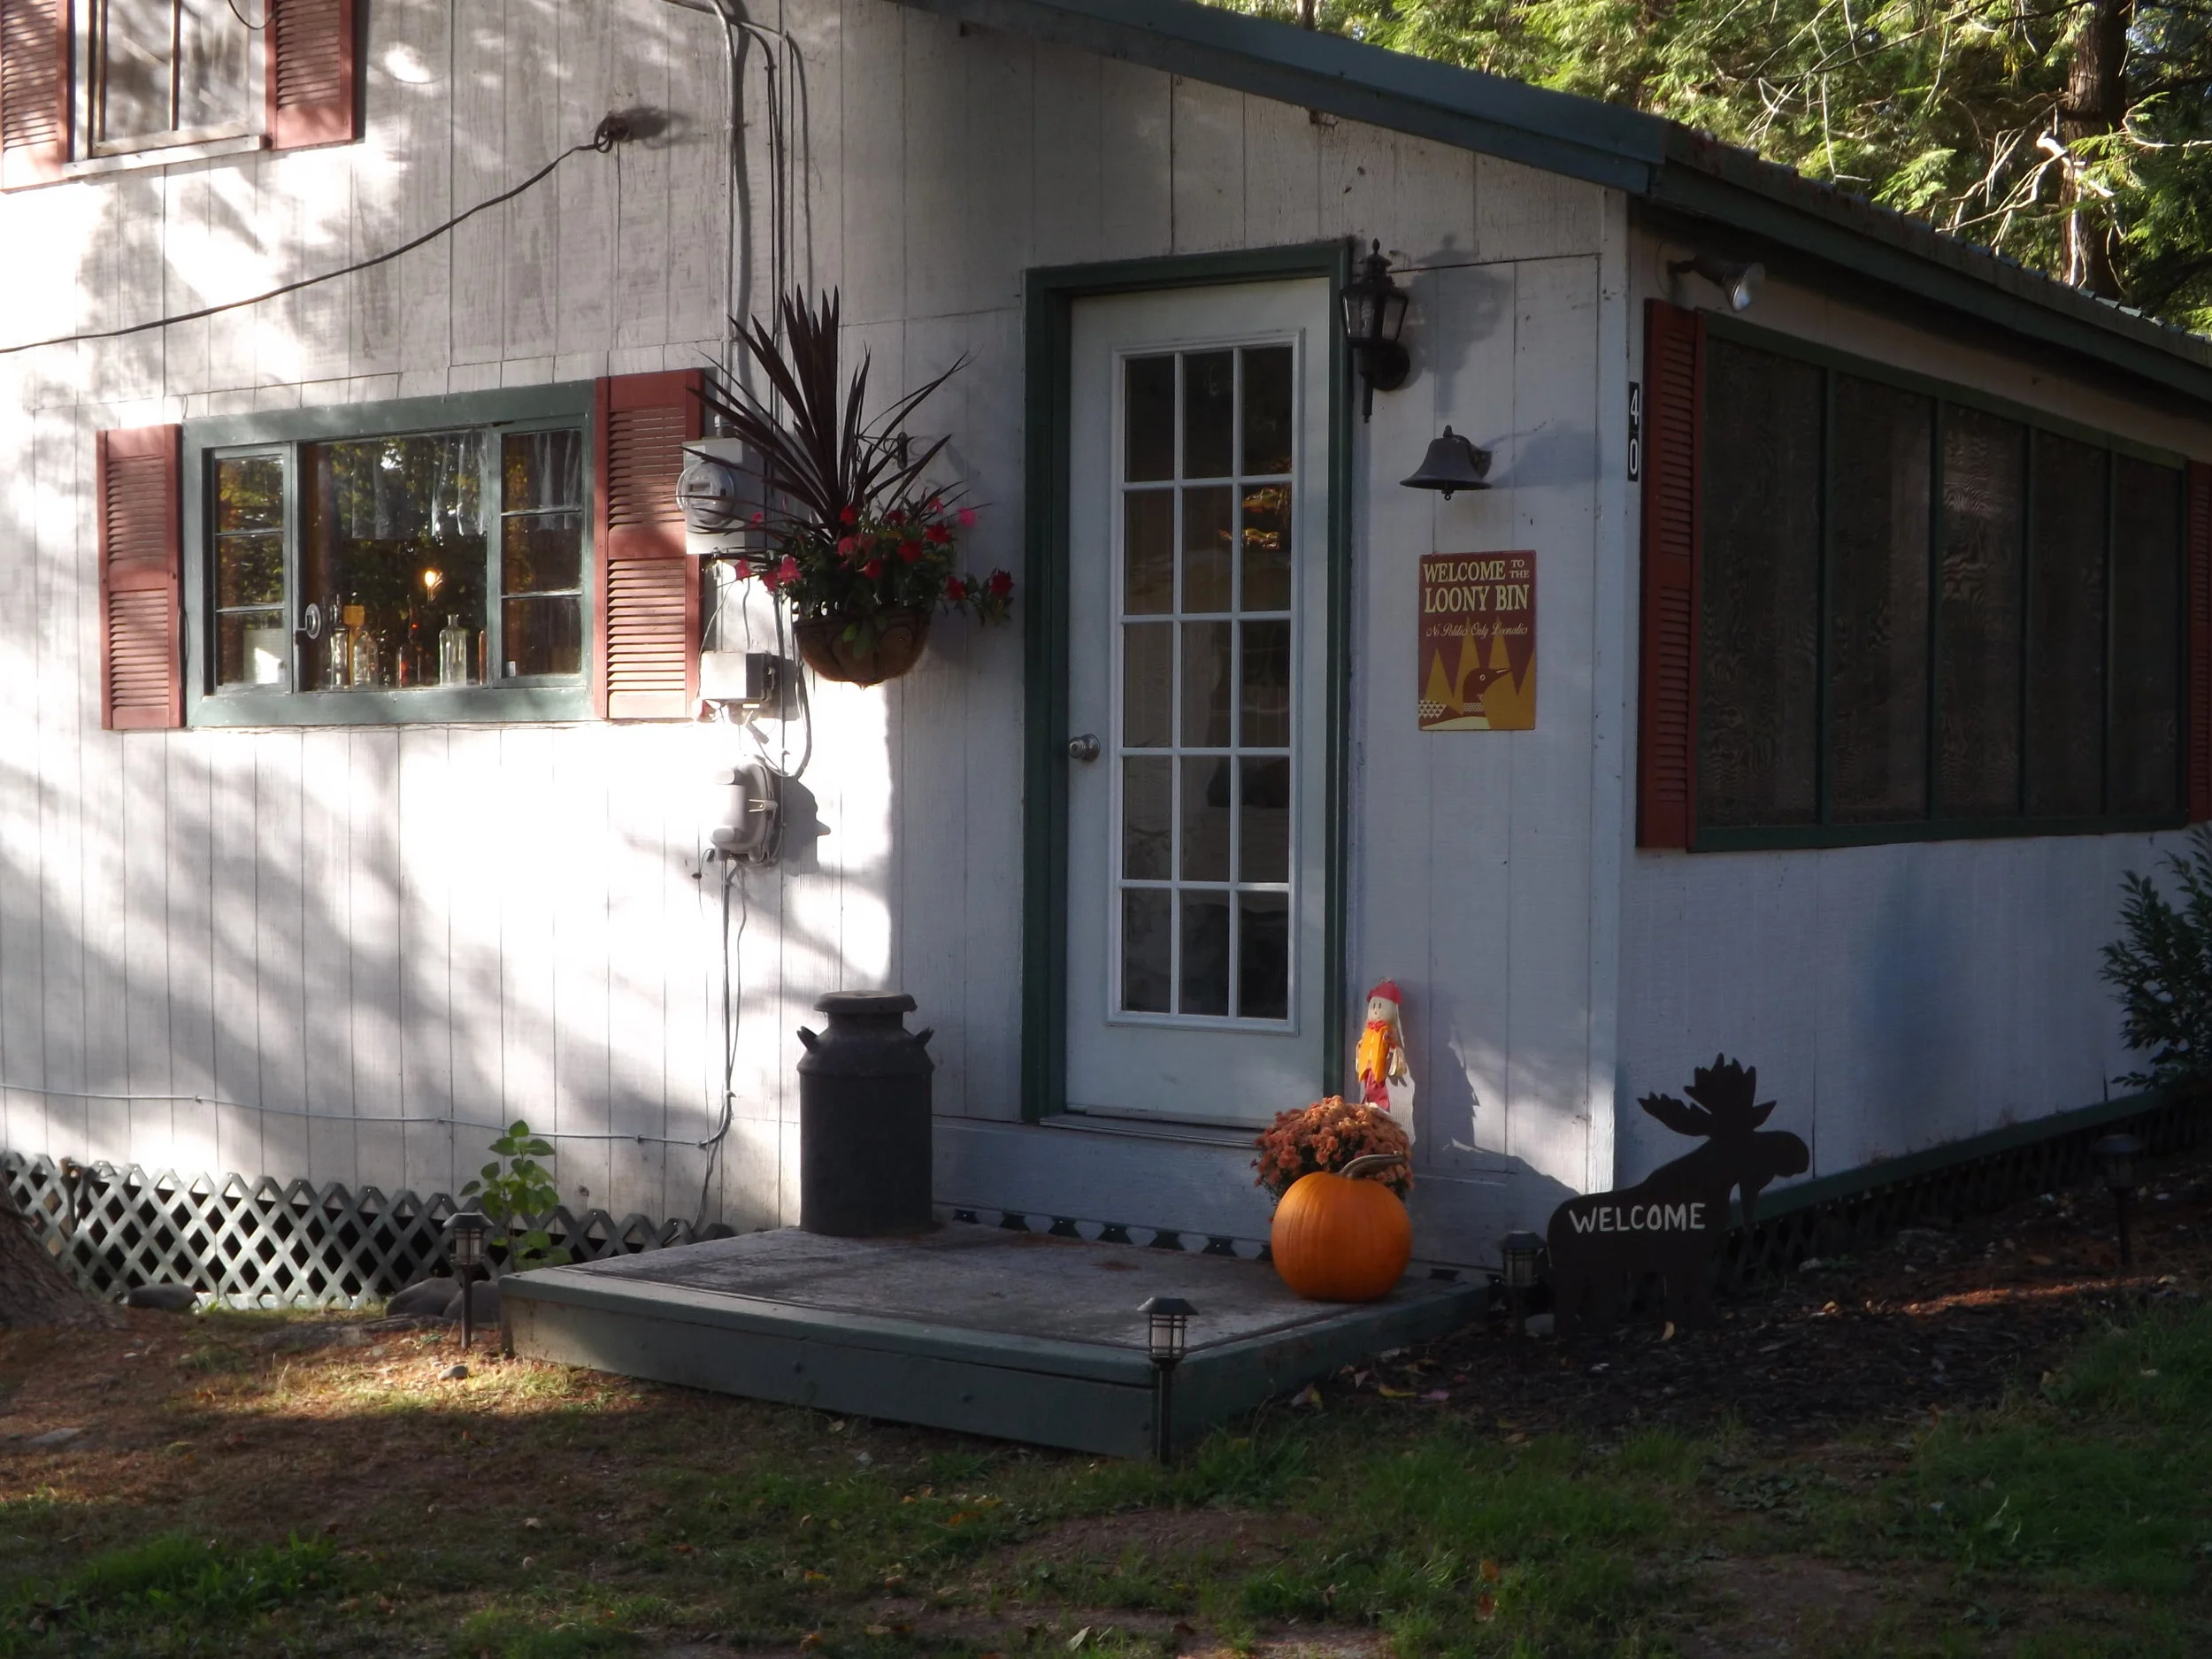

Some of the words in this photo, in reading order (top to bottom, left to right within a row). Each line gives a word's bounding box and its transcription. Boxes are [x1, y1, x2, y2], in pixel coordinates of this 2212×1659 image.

[1630, 388, 1639, 475] 40
[1423, 560, 1506, 584] WELCOME
[1510, 559, 1525, 568] TO
[1509, 570, 1530, 579] THE
[1424, 585, 1490, 613] LOONY
[1494, 584, 1530, 611] BIN
[1471, 622, 1489, 639] Only
[1569, 1202, 1706, 1233] WELCOME
